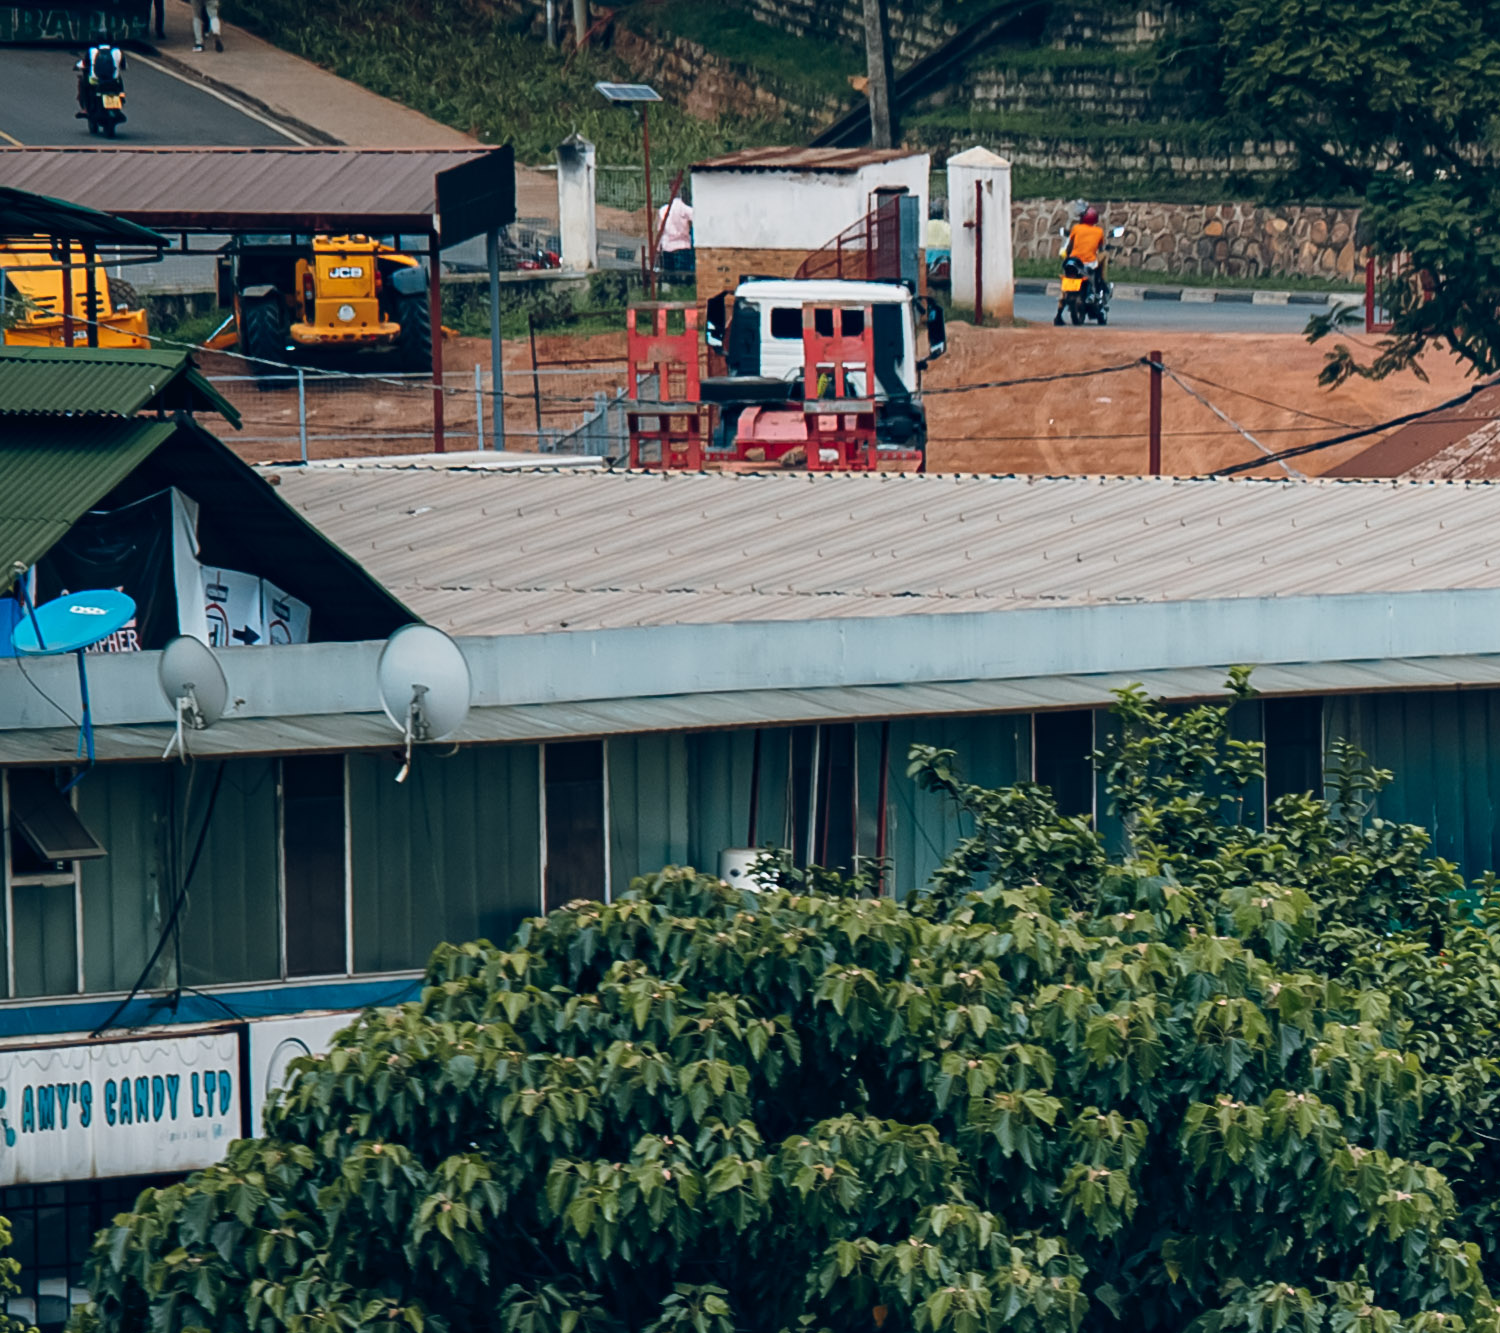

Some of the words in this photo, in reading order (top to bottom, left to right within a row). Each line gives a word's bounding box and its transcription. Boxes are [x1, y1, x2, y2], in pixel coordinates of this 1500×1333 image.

[329, 267, 362, 278] JCB
[22, 1080, 92, 1133] AMY'S
[104, 1074, 180, 1127] CANDY
[191, 1069, 232, 1118] LTD
